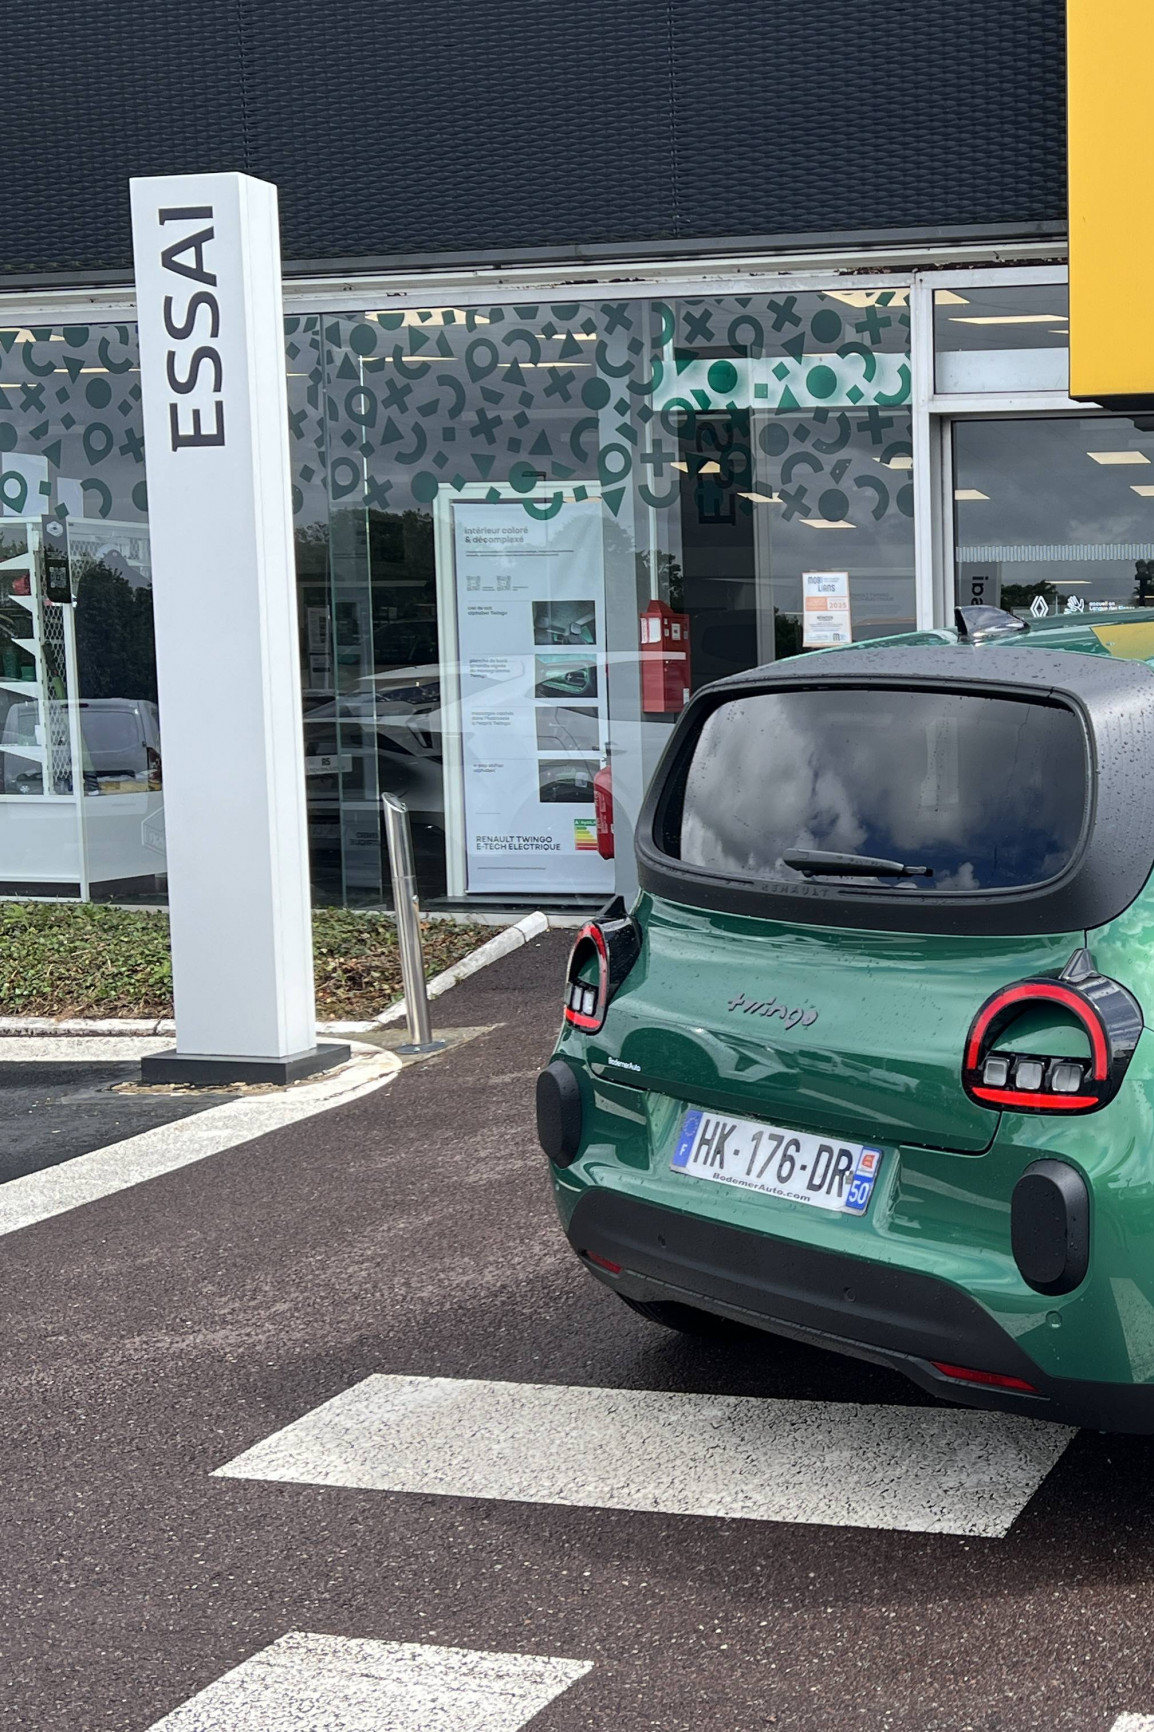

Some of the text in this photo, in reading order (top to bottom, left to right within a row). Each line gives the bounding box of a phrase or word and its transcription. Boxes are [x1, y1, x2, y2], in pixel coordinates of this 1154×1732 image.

[158, 206, 225, 452] ESSAI
[464, 536, 472, 544] &
[475, 835, 553, 843] RENAULT TWINGO
[476, 843, 561, 851] E-TECH ELECTRIQUE
[761, 883, 829, 898] RENAULT
[727, 992, 819, 1031] twingo
[679, 1143, 688, 1156] F
[712, 1172, 811, 1202] BodemerAuto.com
[848, 1180, 871, 1205] 50
